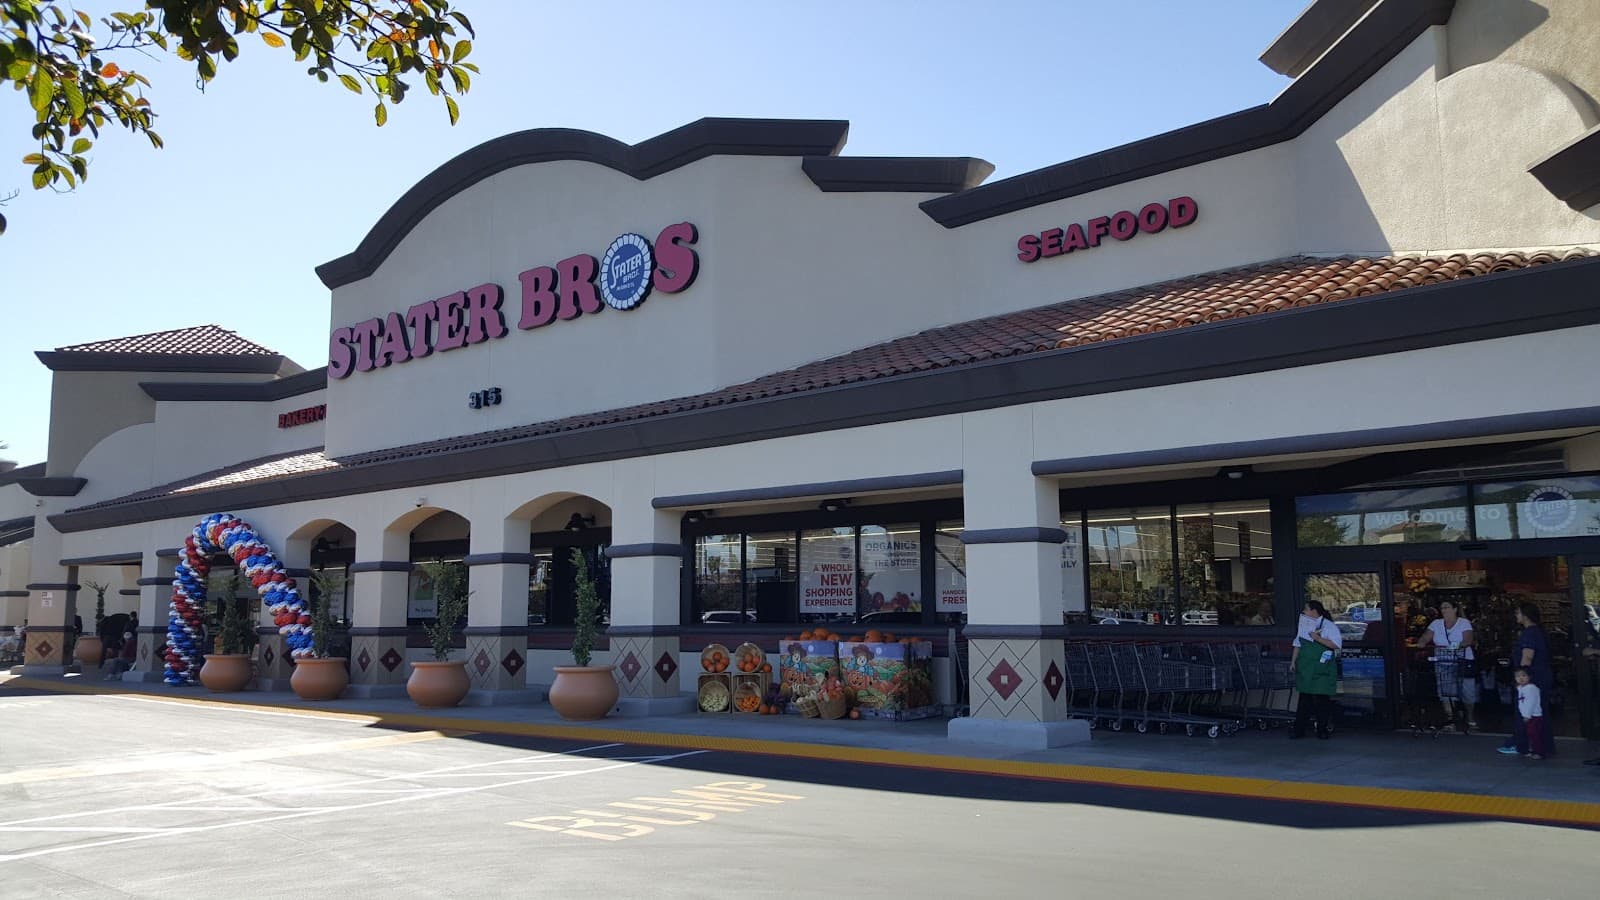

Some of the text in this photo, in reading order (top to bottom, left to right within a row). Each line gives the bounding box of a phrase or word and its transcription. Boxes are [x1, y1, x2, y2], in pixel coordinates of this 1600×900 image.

[1017, 196, 1199, 263] SEAFOOD
[610, 253, 642, 289] STATER
[328, 283, 509, 379] STATER
[469, 387, 502, 410] 315
[1376, 505, 1500, 526] welcome to
[865, 540, 917, 552] ORGANICS
[813, 563, 853, 572] A WHOLE
[890, 558, 917, 567] STORE
[1405, 566, 1431, 578] eat
[820, 573, 853, 586] NEW
[805, 587, 853, 597] SHOPPING
[805, 598, 853, 607] EXPERIENCE
[504, 781, 806, 842] BUMP
